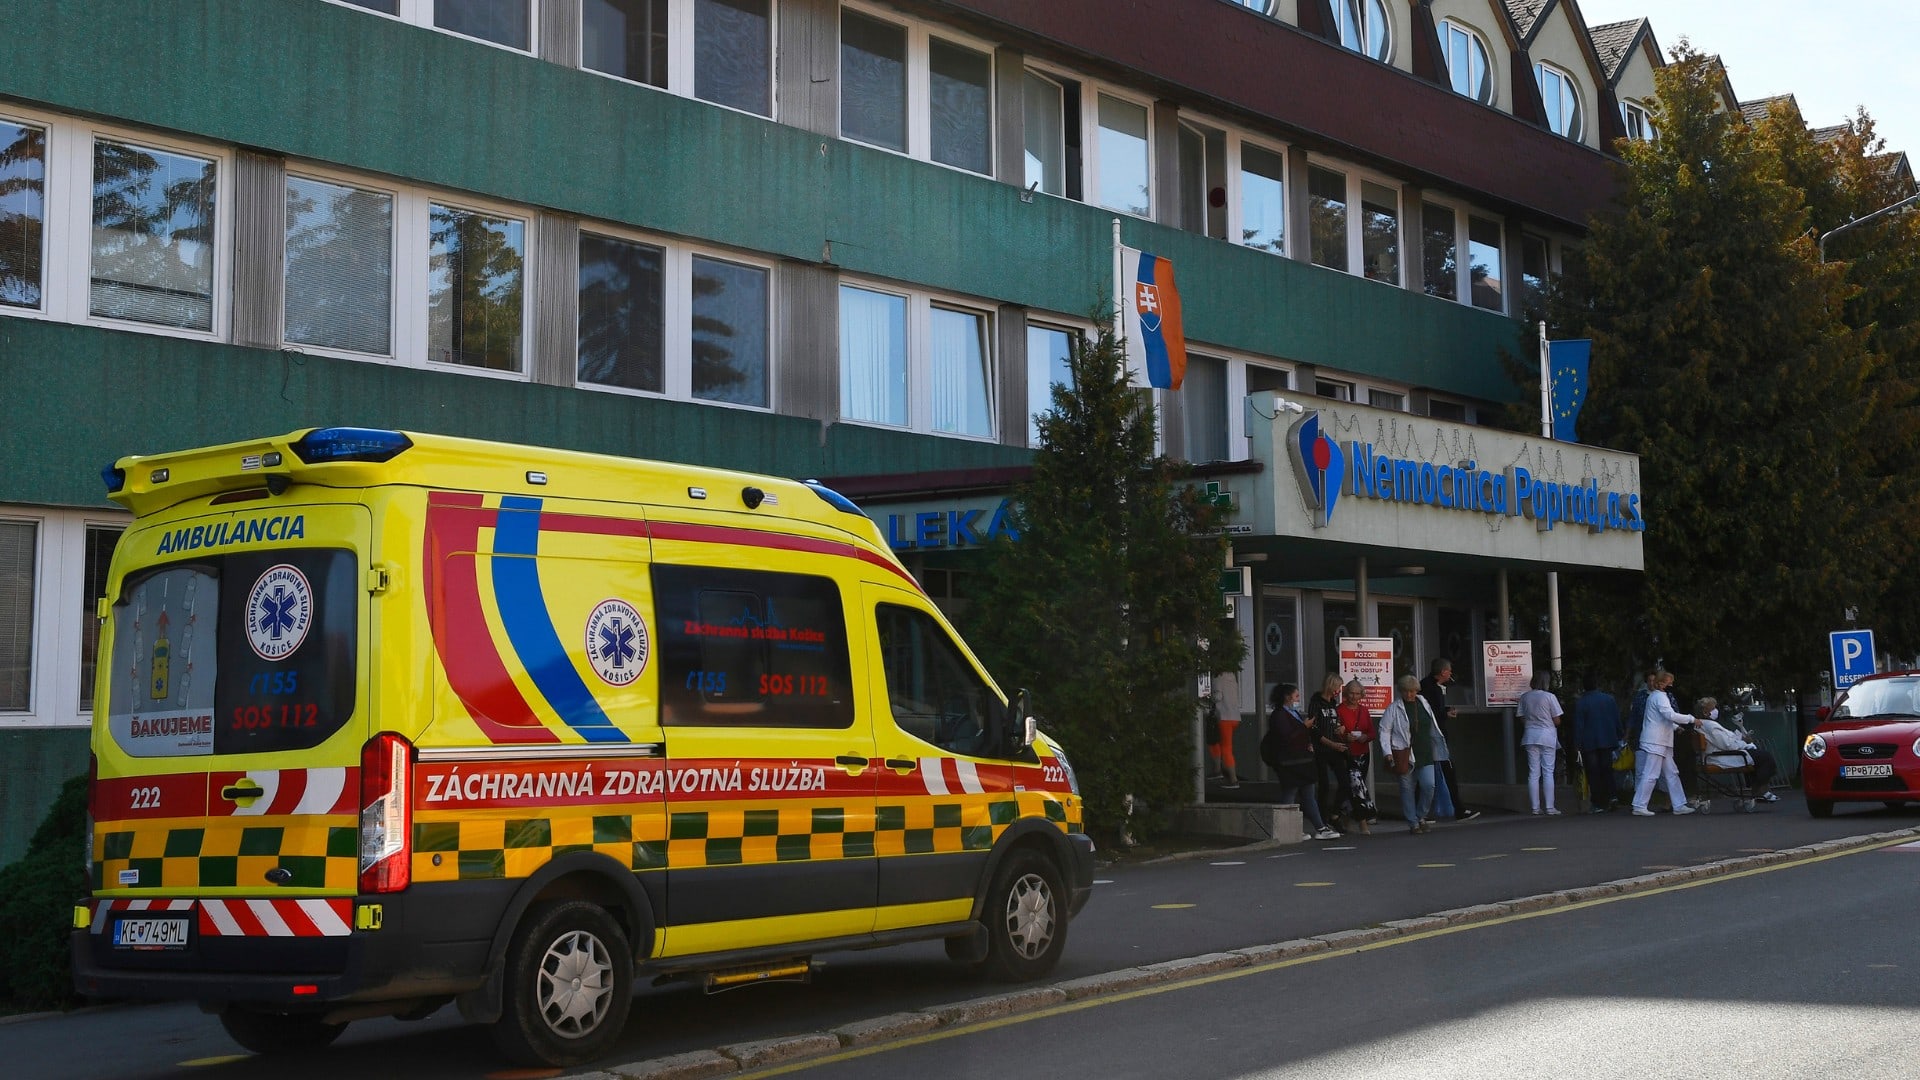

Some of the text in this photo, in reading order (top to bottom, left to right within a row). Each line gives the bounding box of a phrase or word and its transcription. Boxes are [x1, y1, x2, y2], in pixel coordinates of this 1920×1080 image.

[1352, 441, 1507, 514] Nemocnica
[156, 515, 305, 555] AMBULANCIA
[888, 497, 1020, 549] LEKÁ
[1842, 638, 1862, 670] P
[759, 674, 827, 695] SOS 112
[131, 716, 212, 738] ĎAKUJEME
[232, 703, 318, 729] SOS 112
[426, 761, 826, 802] ZÁCHRANNÁ ZDRAVOTNÁ SLUŽBA
[1043, 766, 1064, 782] 222
[131, 787, 161, 809] 222
